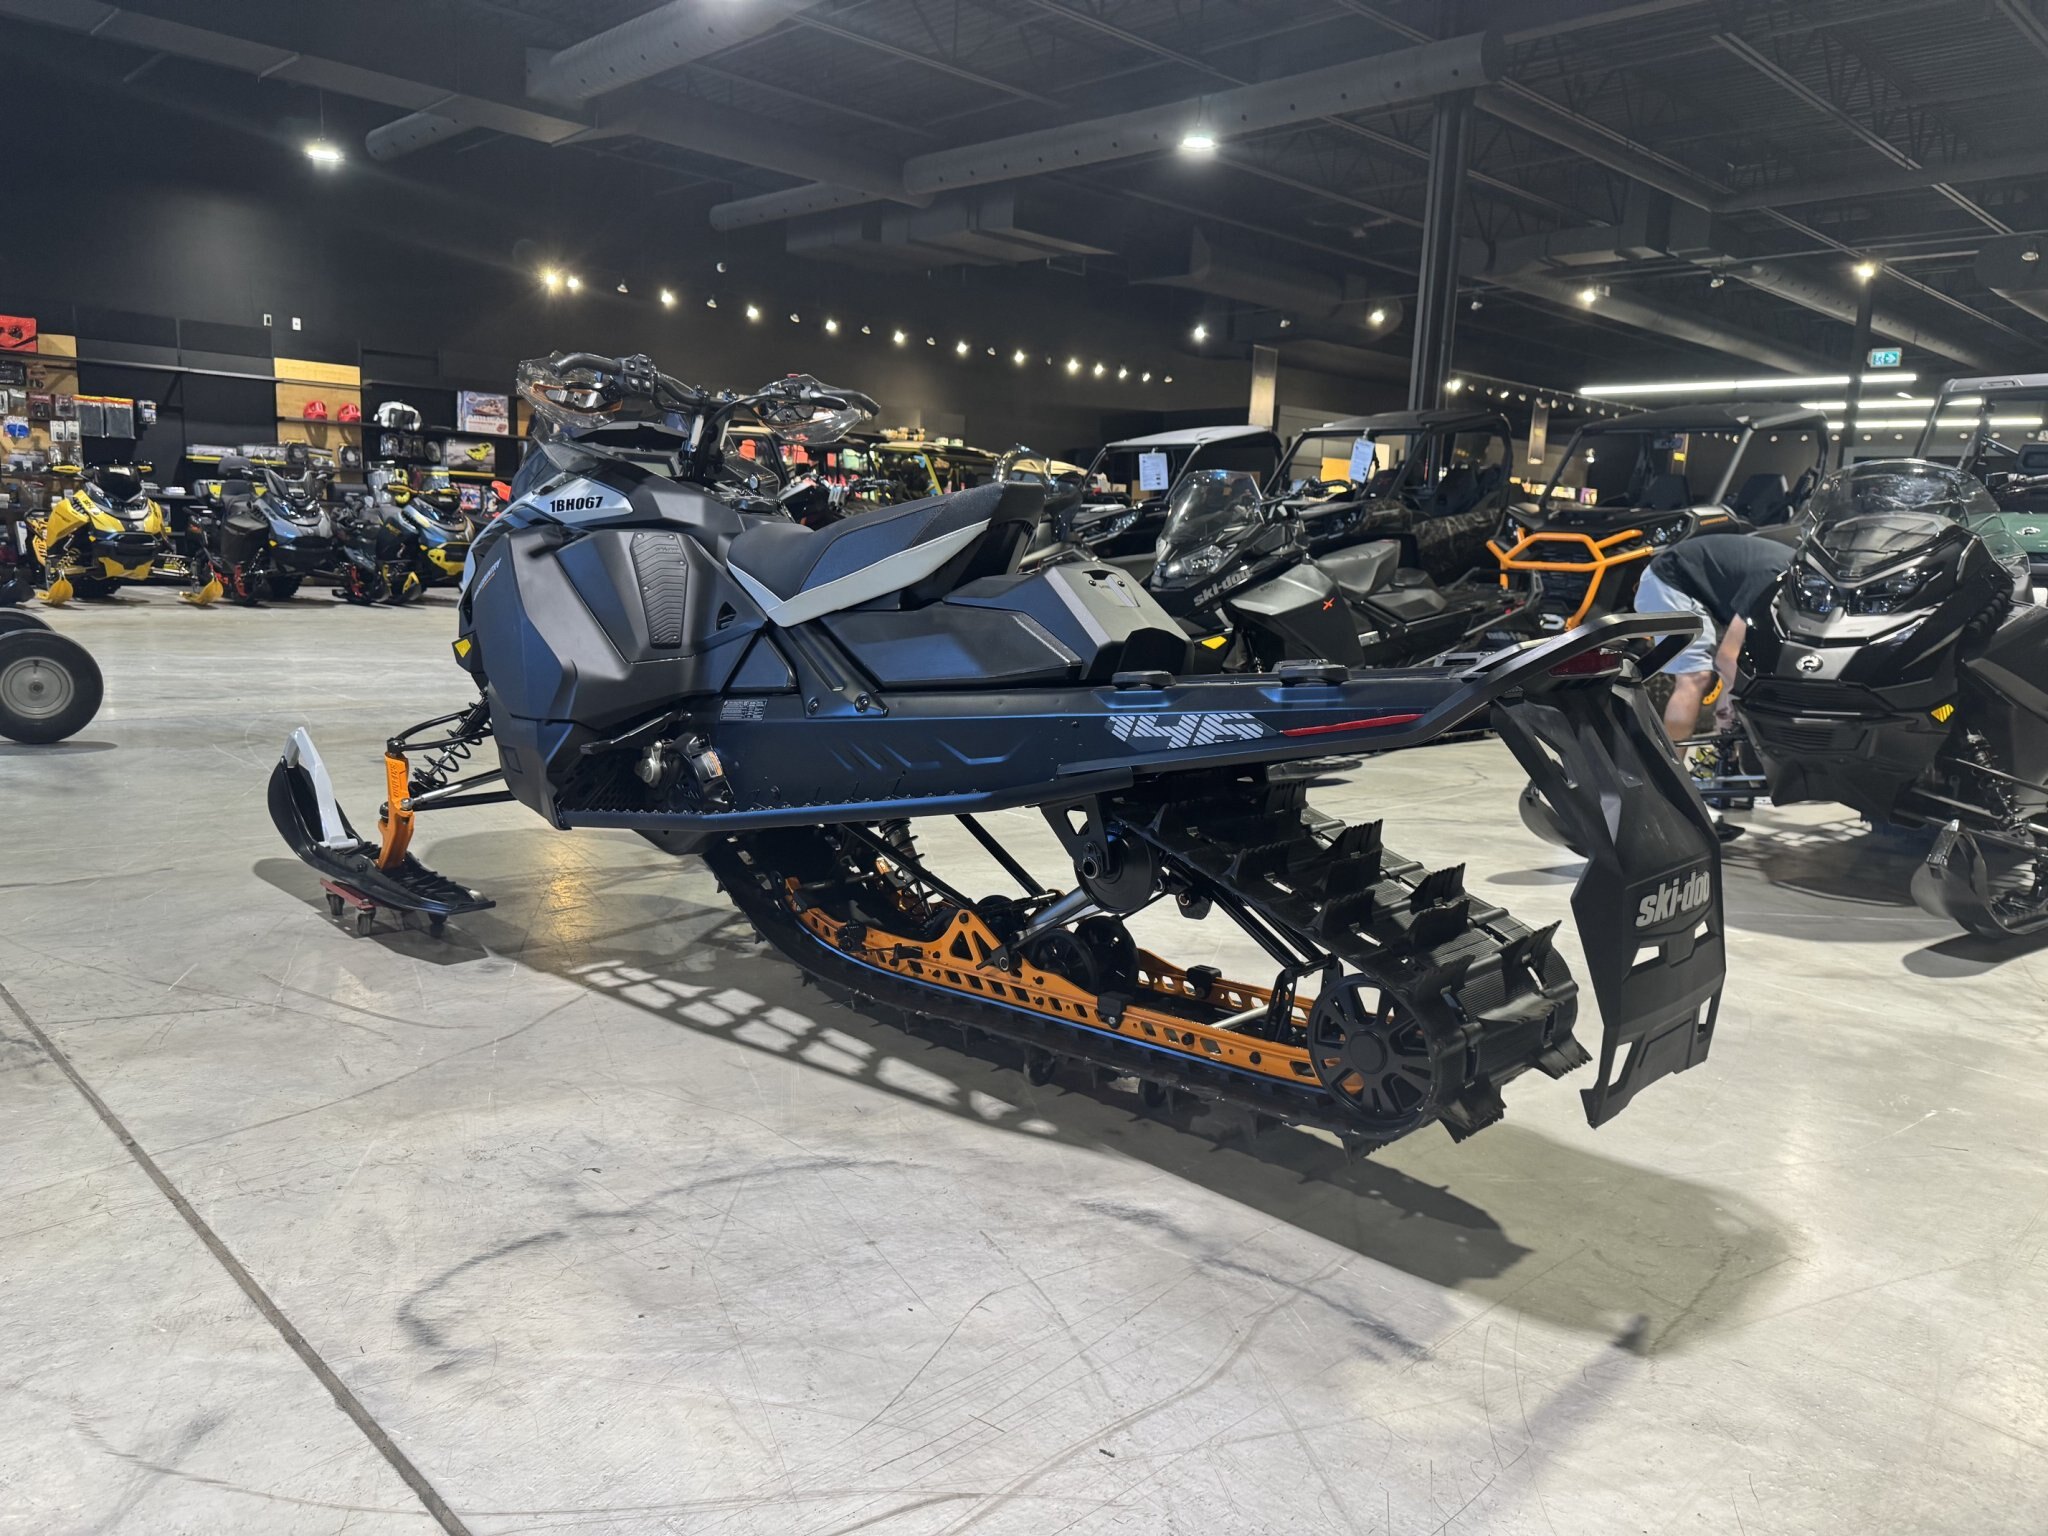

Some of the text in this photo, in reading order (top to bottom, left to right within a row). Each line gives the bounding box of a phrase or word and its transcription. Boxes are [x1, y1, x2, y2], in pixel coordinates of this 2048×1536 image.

[550, 496, 603, 512] 1BH067
[1193, 569, 1252, 606] ski-doo
[1108, 712, 1264, 750] 146
[1635, 870, 1711, 928] ski-doo
